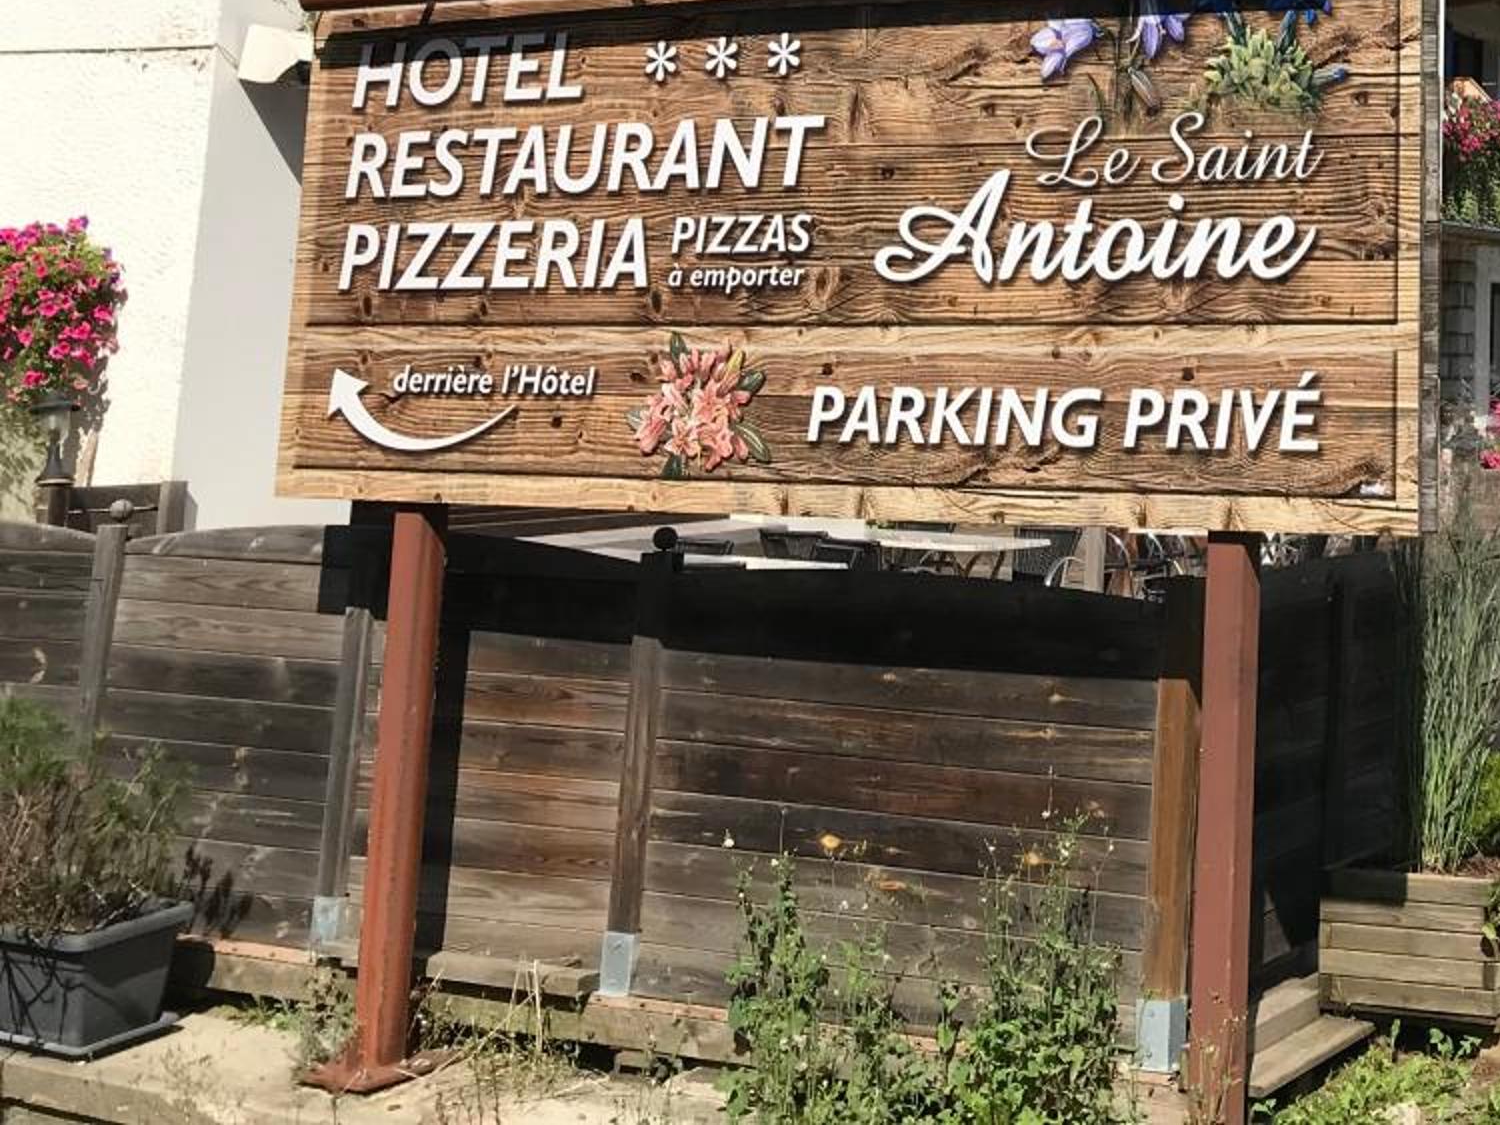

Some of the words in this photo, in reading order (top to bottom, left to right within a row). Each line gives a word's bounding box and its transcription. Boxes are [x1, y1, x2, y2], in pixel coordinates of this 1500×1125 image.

[351, 31, 584, 109] HOTEL
[344, 115, 826, 200] RESTAURANT
[1025, 115, 1141, 188] Le
[1151, 112, 1326, 185] Saint
[337, 218, 650, 291] PIZZERIA
[671, 213, 812, 254] PIZZAS
[873, 167, 1316, 284] Antoine
[668, 262, 684, 287] à
[689, 265, 806, 294] emporter
[392, 364, 493, 394] derrière
[501, 365, 595, 395] l’Hôtel
[806, 385, 1101, 449] PARKING
[1123, 371, 1322, 452] PRIVÉ
